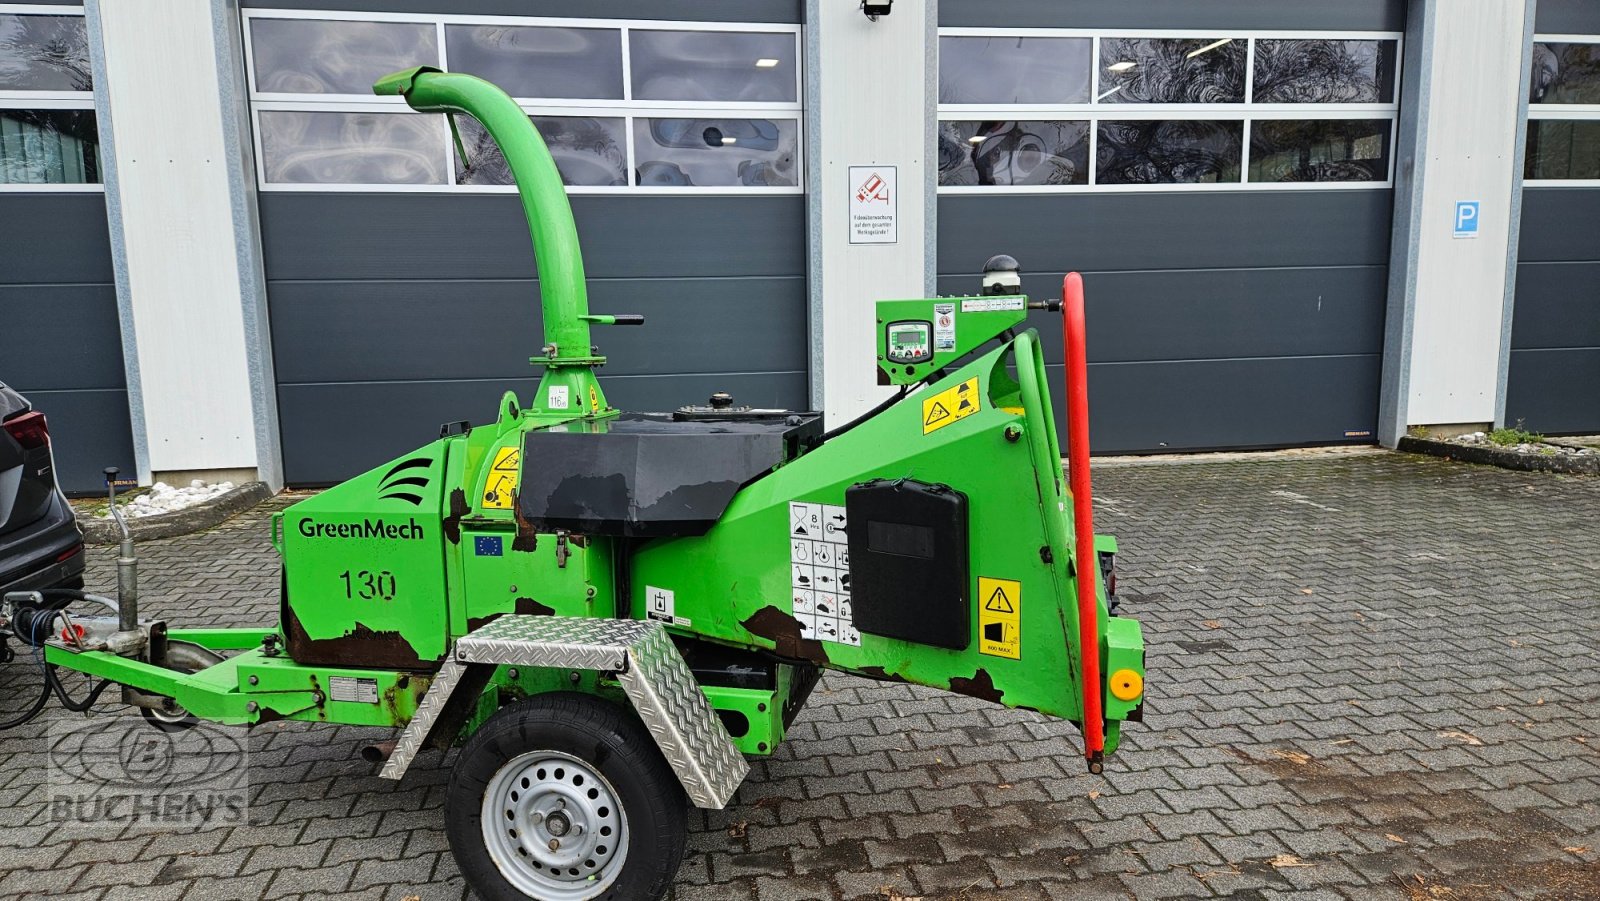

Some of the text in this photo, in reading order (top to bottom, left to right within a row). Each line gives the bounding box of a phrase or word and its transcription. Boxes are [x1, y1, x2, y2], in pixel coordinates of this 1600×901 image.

[1458, 204, 1476, 229] P
[298, 517, 424, 540] GreenMech
[811, 513, 818, 524] 8
[339, 570, 396, 601] 130
